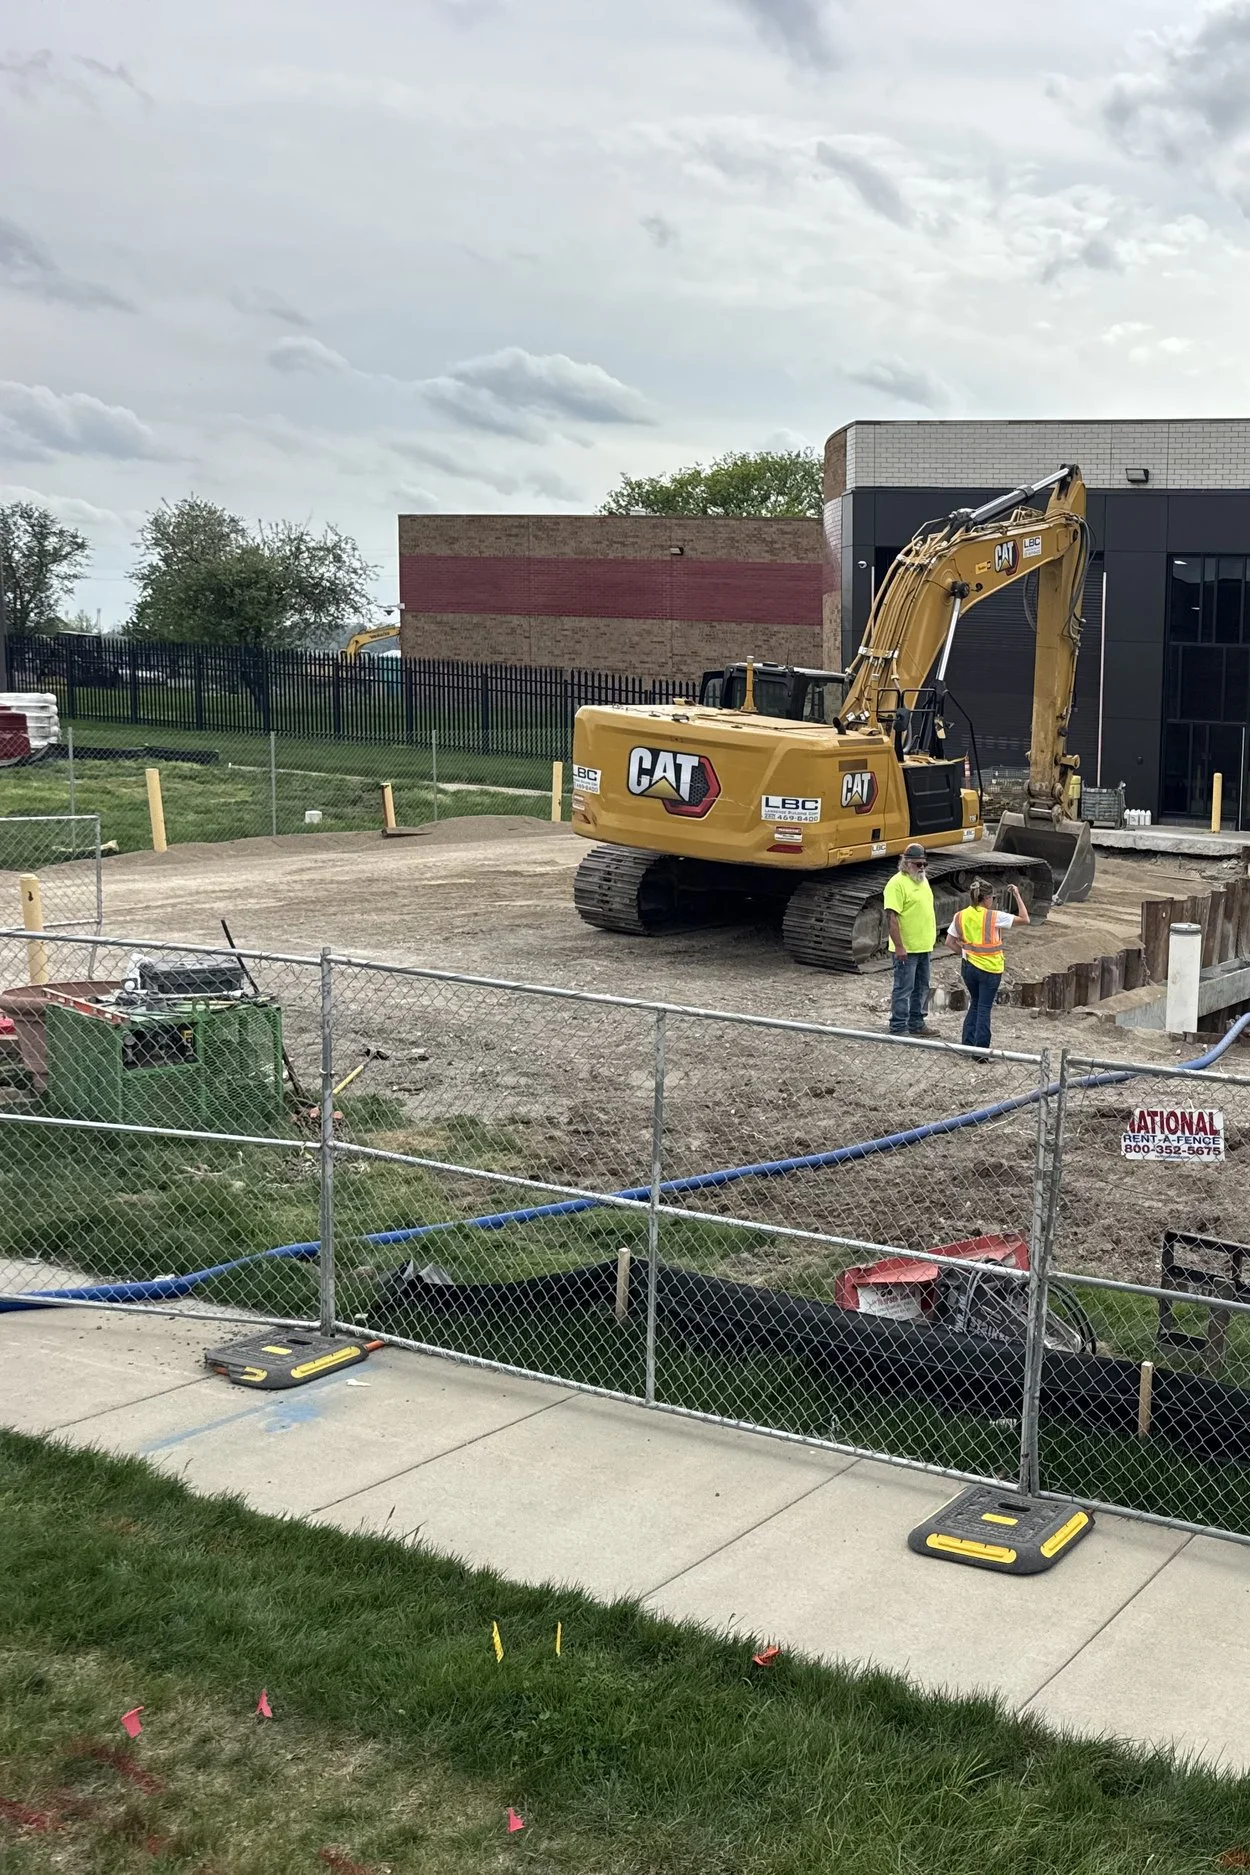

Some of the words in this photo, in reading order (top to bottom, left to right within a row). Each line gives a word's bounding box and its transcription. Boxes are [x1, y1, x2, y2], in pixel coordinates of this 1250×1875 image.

[1024, 537, 1040, 548] LBC
[995, 541, 1014, 573] CAT
[628, 747, 700, 802] CAT
[841, 772, 871, 807] CAT
[765, 796, 819, 811] LBC
[777, 814, 819, 822] 469-8400
[1123, 1134, 1220, 1145] RENT-A-FENCE
[1124, 1145, 1221, 1155] 800-352-5675
